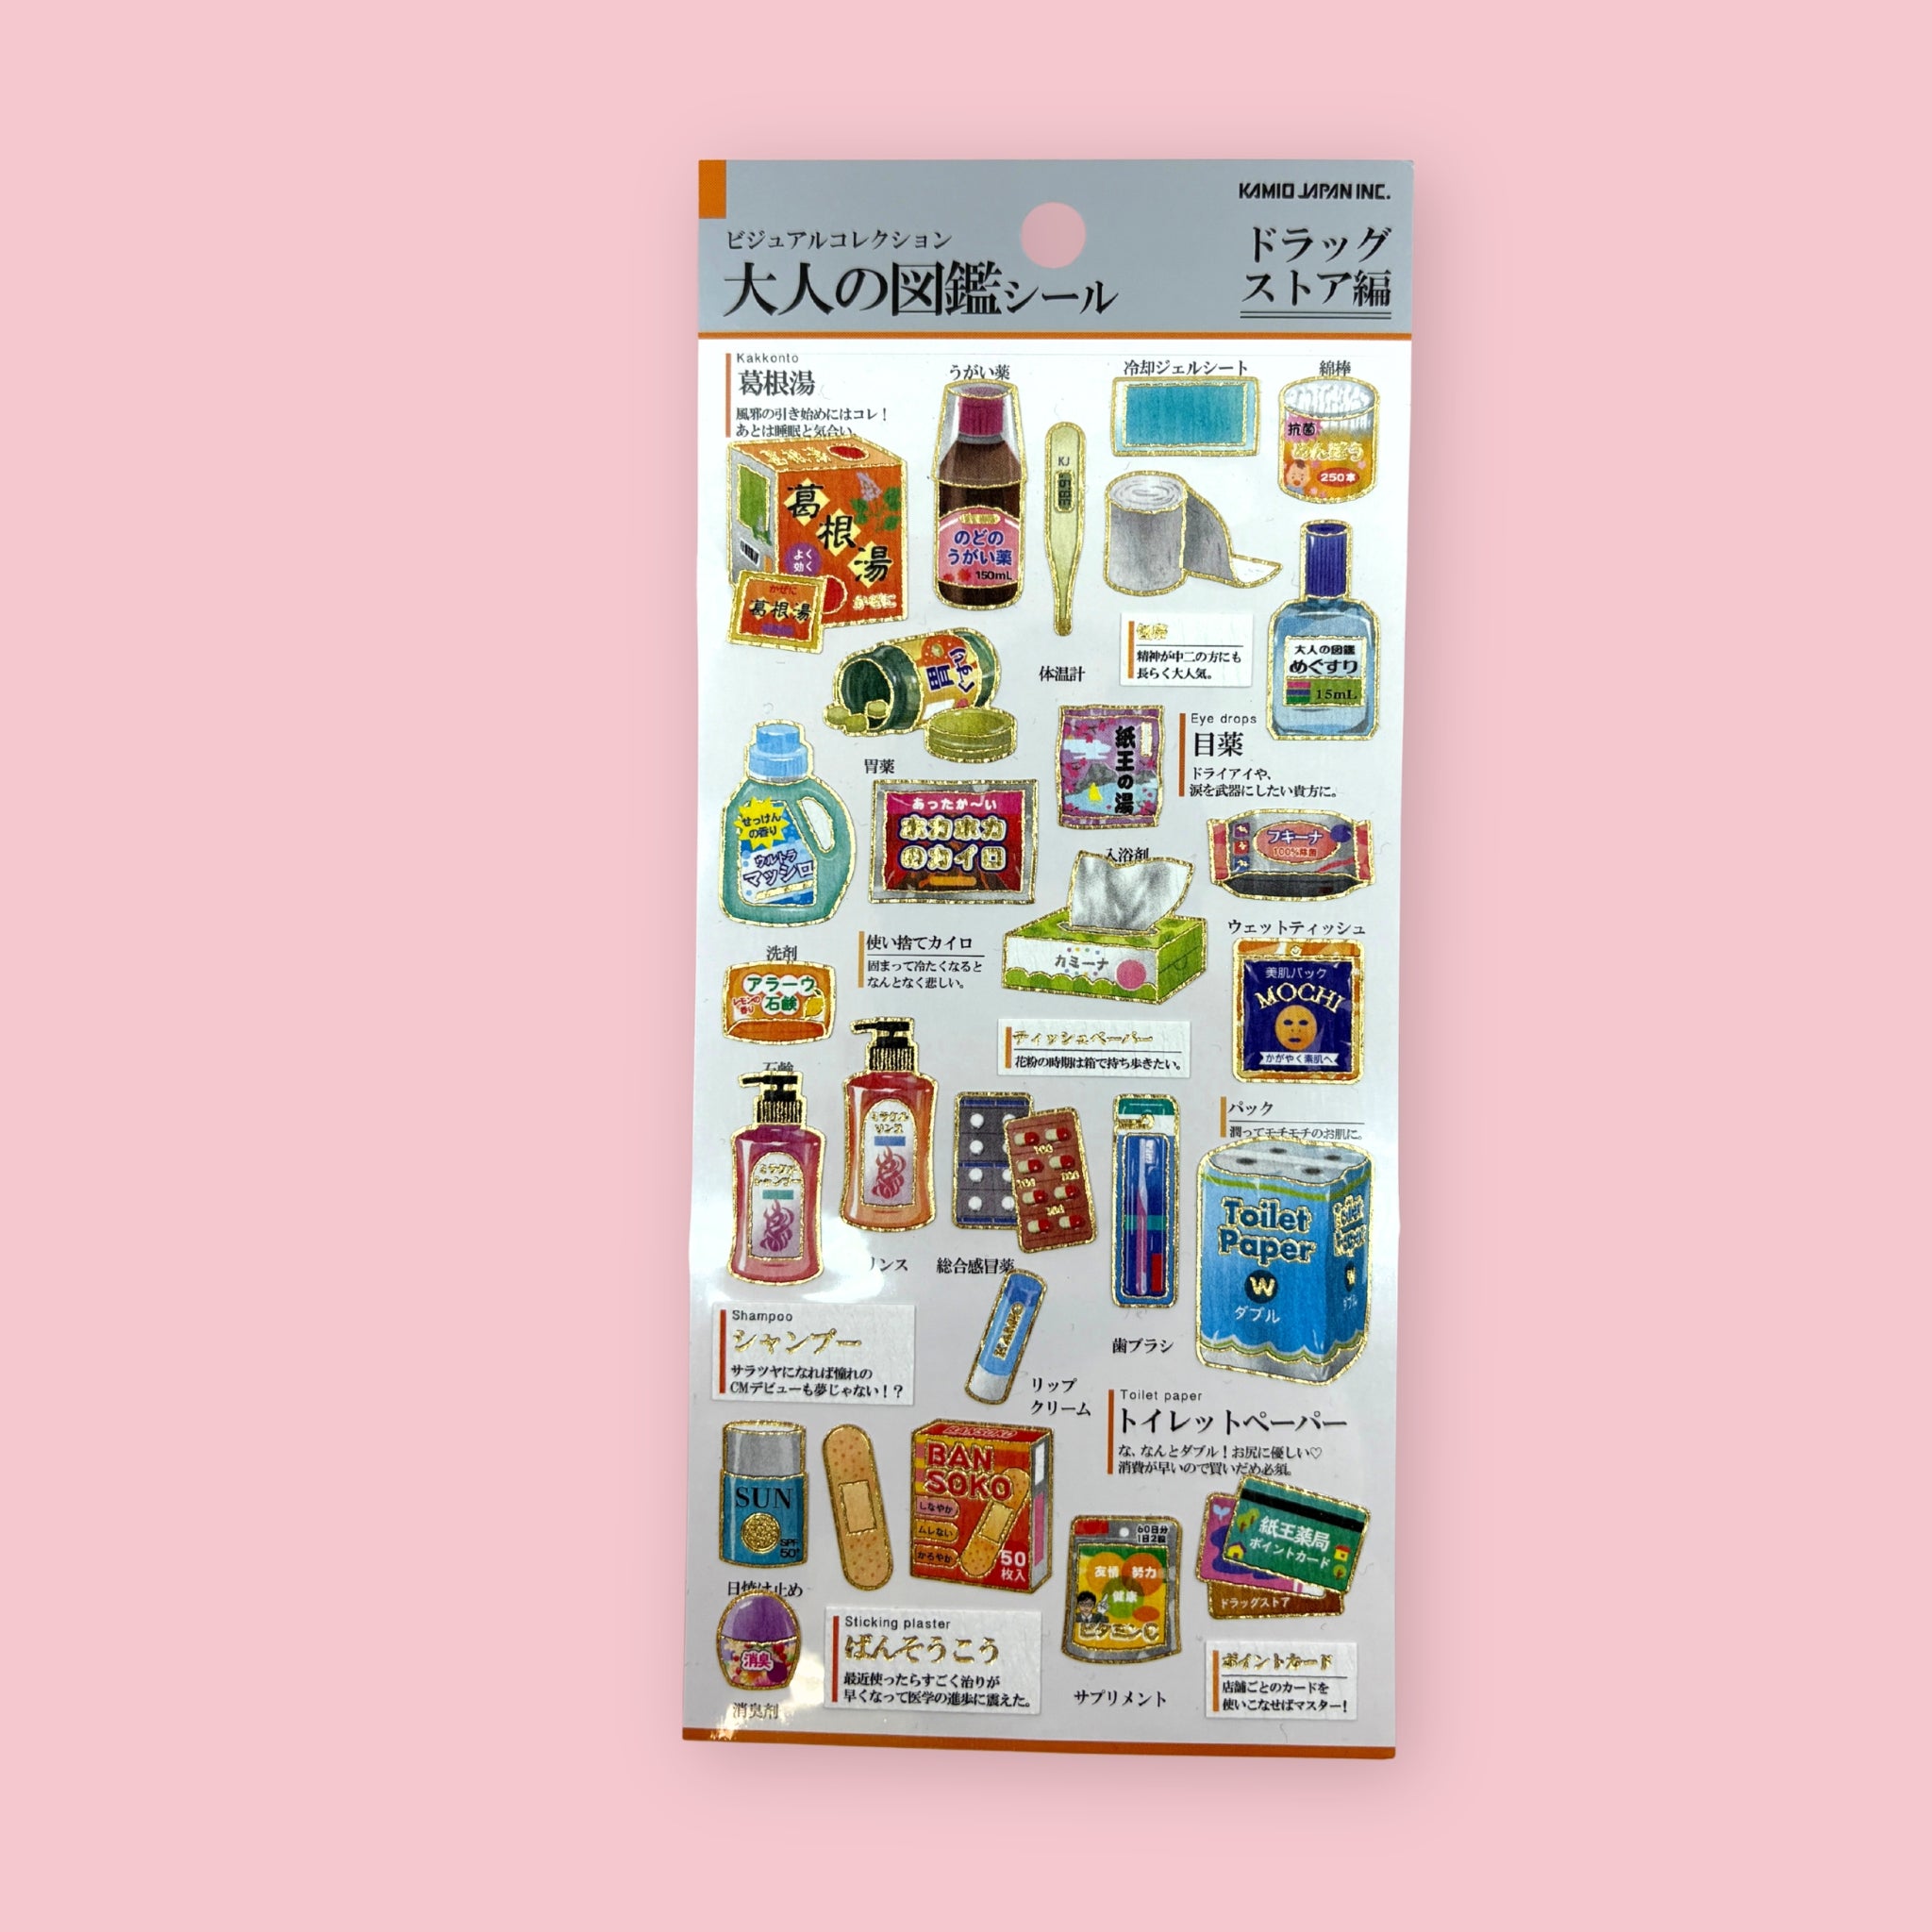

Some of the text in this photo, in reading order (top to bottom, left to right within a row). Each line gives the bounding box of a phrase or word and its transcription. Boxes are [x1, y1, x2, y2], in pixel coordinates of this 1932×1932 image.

[1239, 183, 1391, 200] KAMIO JAPAN INC.
[727, 230, 953, 250] ビジュアルコレクション
[1253, 226, 1391, 263] ドラッグ
[724, 260, 1119, 317] 大人の図鑑シール
[1241, 269, 1391, 307] ストア編
[737, 353, 799, 363] Kakkonto
[949, 364, 1010, 381] うがい薬
[1124, 359, 1247, 376] 冷却ジェルシート
[1319, 359, 1351, 377] 綿棒
[738, 370, 815, 396] 葛根湯
[736, 407, 887, 422] 風邪の引き始めにはコレ！
[1288, 423, 1316, 436] 抗菌
[1058, 458, 1071, 466] KJ
[787, 483, 892, 583] 葛根湯
[955, 530, 1004, 546] のどの
[793, 549, 812, 560] よく
[948, 549, 1012, 566] うがい薬
[793, 561, 812, 572] 効く
[975, 570, 1012, 580] 150mL
[749, 599, 812, 621] 葛根湯
[1136, 650, 1241, 663] 精神が中二の方にも
[1294, 644, 1356, 656] 大人の図鑑
[1038, 664, 1086, 682] 体温計
[1136, 667, 1213, 679] 長らく大人気。
[1290, 659, 1357, 675] めぐすり
[1315, 689, 1357, 700] 15mL
[1191, 713, 1257, 725] Eye drops
[1193, 732, 1244, 758] 目薬
[864, 758, 895, 774] 胃薬
[1115, 725, 1136, 815] 紙王の湯
[1191, 767, 1272, 780] ドライアイや、
[1190, 783, 1338, 798] 涙を武器にしたい貴方に。
[741, 813, 781, 826] せっけん
[749, 824, 777, 838] の香り
[1268, 829, 1323, 845] フキーナ
[755, 849, 798, 869] ウルトラ
[743, 859, 813, 888] マッシロ
[1227, 920, 1366, 935] ウェットティッシュ
[866, 934, 972, 951] 使い捨てカイロ
[767, 945, 797, 961] 洗剤
[867, 960, 982, 973] 固まって冷たくなると
[1054, 955, 1109, 971] カミーナ
[867, 976, 964, 990] なんとなく悲しい。
[1255, 982, 1346, 1013] MOCHI
[1015, 1056, 1181, 1070] 花粉の時期は箱で持ち歩きたい。
[1266, 1054, 1333, 1063] かがやく素肌へ
[1228, 1102, 1274, 1116] パック
[1221, 1197, 1312, 1233] Toilet
[1218, 1226, 1316, 1266] Paper
[937, 1257, 1014, 1274] 総合感冒薬
[1250, 1276, 1275, 1296] W
[732, 1309, 792, 1324] Shampoo
[1235, 1307, 1280, 1324] ダブル
[1112, 1339, 1174, 1354] 歯ブラシ
[731, 1365, 873, 1380] サラツヤになれば憧れの
[1032, 1377, 1077, 1393] リップ
[1121, 1389, 1202, 1403] Toilet paper
[1030, 1400, 1091, 1416] クリーム
[1122, 1407, 1347, 1436] トイレットペーパー
[926, 1441, 994, 1472] BAN
[1118, 1461, 1292, 1475] 消費が早いので買いだめ必須。
[925, 1468, 1013, 1501] SOKO
[735, 1487, 792, 1508] SUN
[919, 1501, 953, 1514] しなやか
[918, 1525, 954, 1537] ムレない
[1259, 1516, 1331, 1552] 紙王薬局
[917, 1552, 953, 1563] かろやか
[1000, 1551, 1025, 1566] 50
[1249, 1536, 1330, 1568] ポイントカード
[1001, 1567, 1025, 1582] 枚入
[1094, 1565, 1120, 1578] 友情
[1132, 1567, 1158, 1578] 努力
[1112, 1591, 1138, 1603] 健康
[845, 1616, 951, 1630] Sticking plaster
[844, 1633, 1000, 1666] ばんそうこう
[741, 1651, 774, 1671] 消臭
[843, 1672, 1000, 1689] 最近使ったらすごく治りが
[1223, 1681, 1329, 1695] 店舗ごとのカードを
[843, 1690, 1030, 1707] 早くなって医学の進歩に震えた。
[1074, 1690, 1166, 1707] サプリメント
[733, 1703, 779, 1719] 消臭剤
